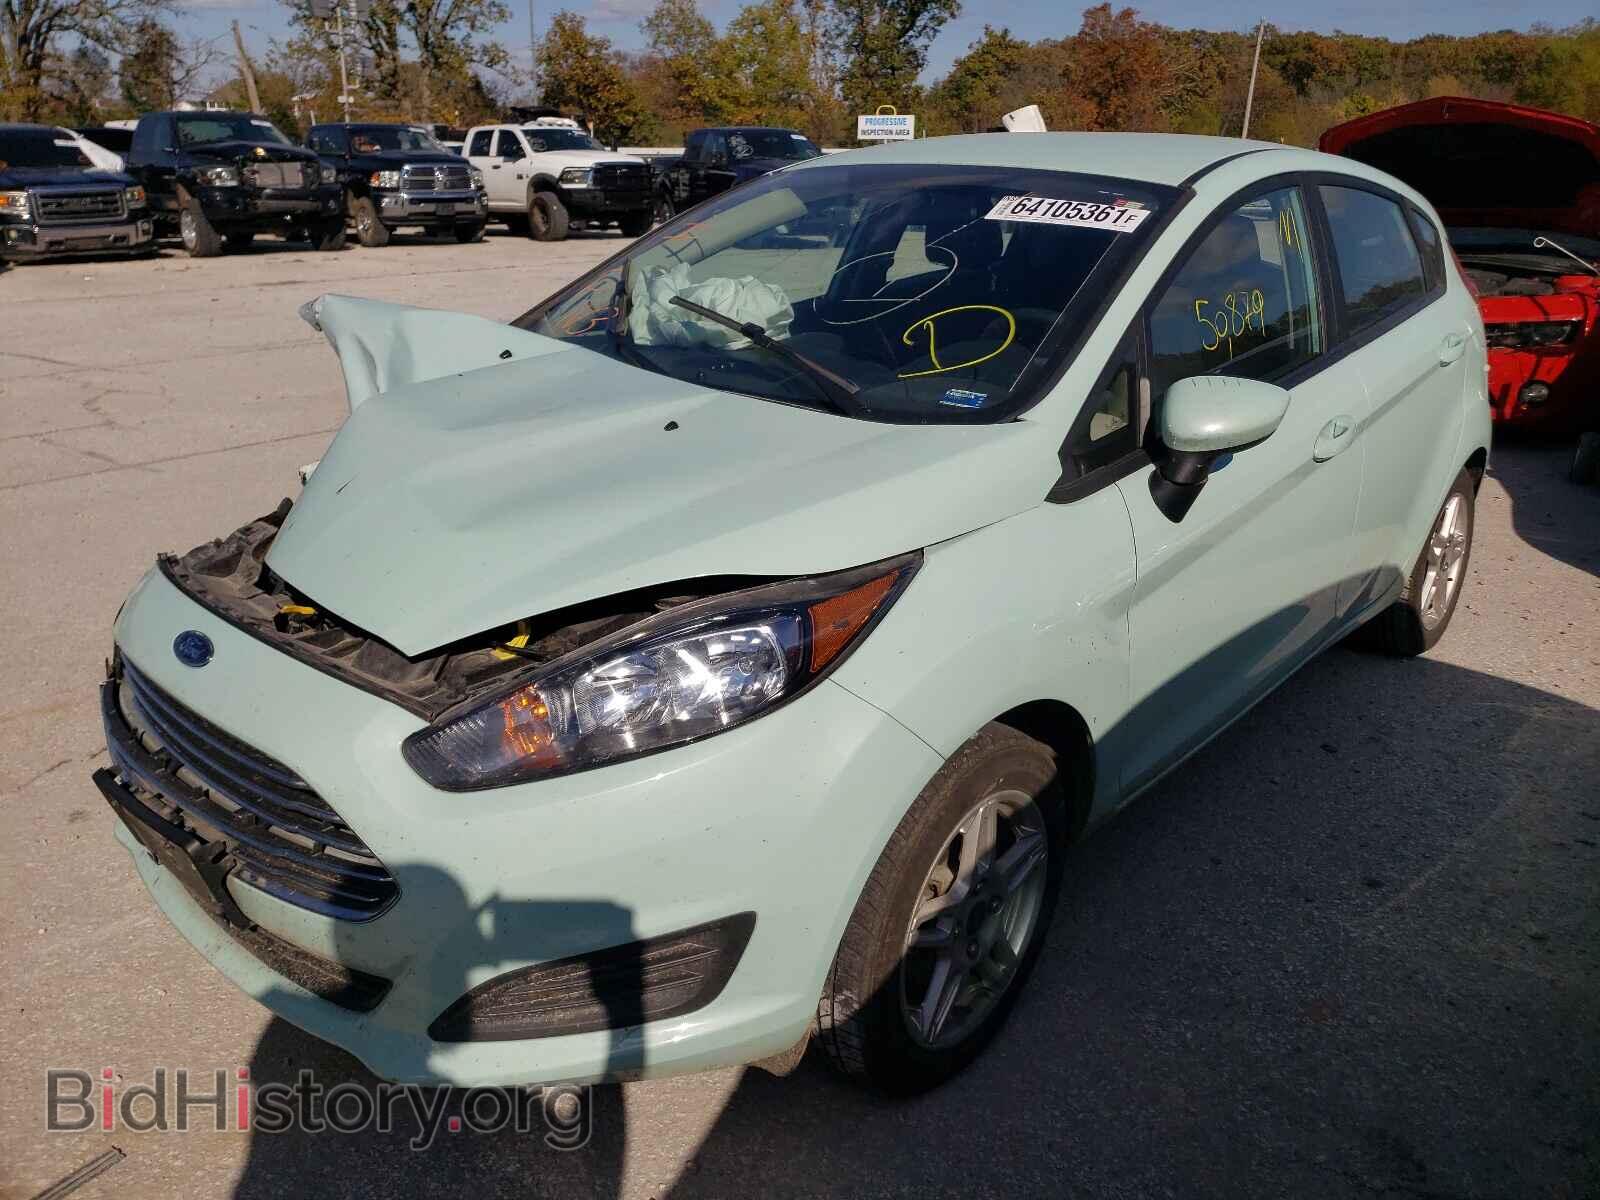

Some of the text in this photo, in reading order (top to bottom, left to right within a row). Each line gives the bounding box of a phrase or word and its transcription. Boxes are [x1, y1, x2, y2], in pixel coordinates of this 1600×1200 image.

[864, 117, 907, 126] PROGRESSIVE
[861, 128, 910, 136] INSPECTION AREA
[897, 304, 1016, 379] D
